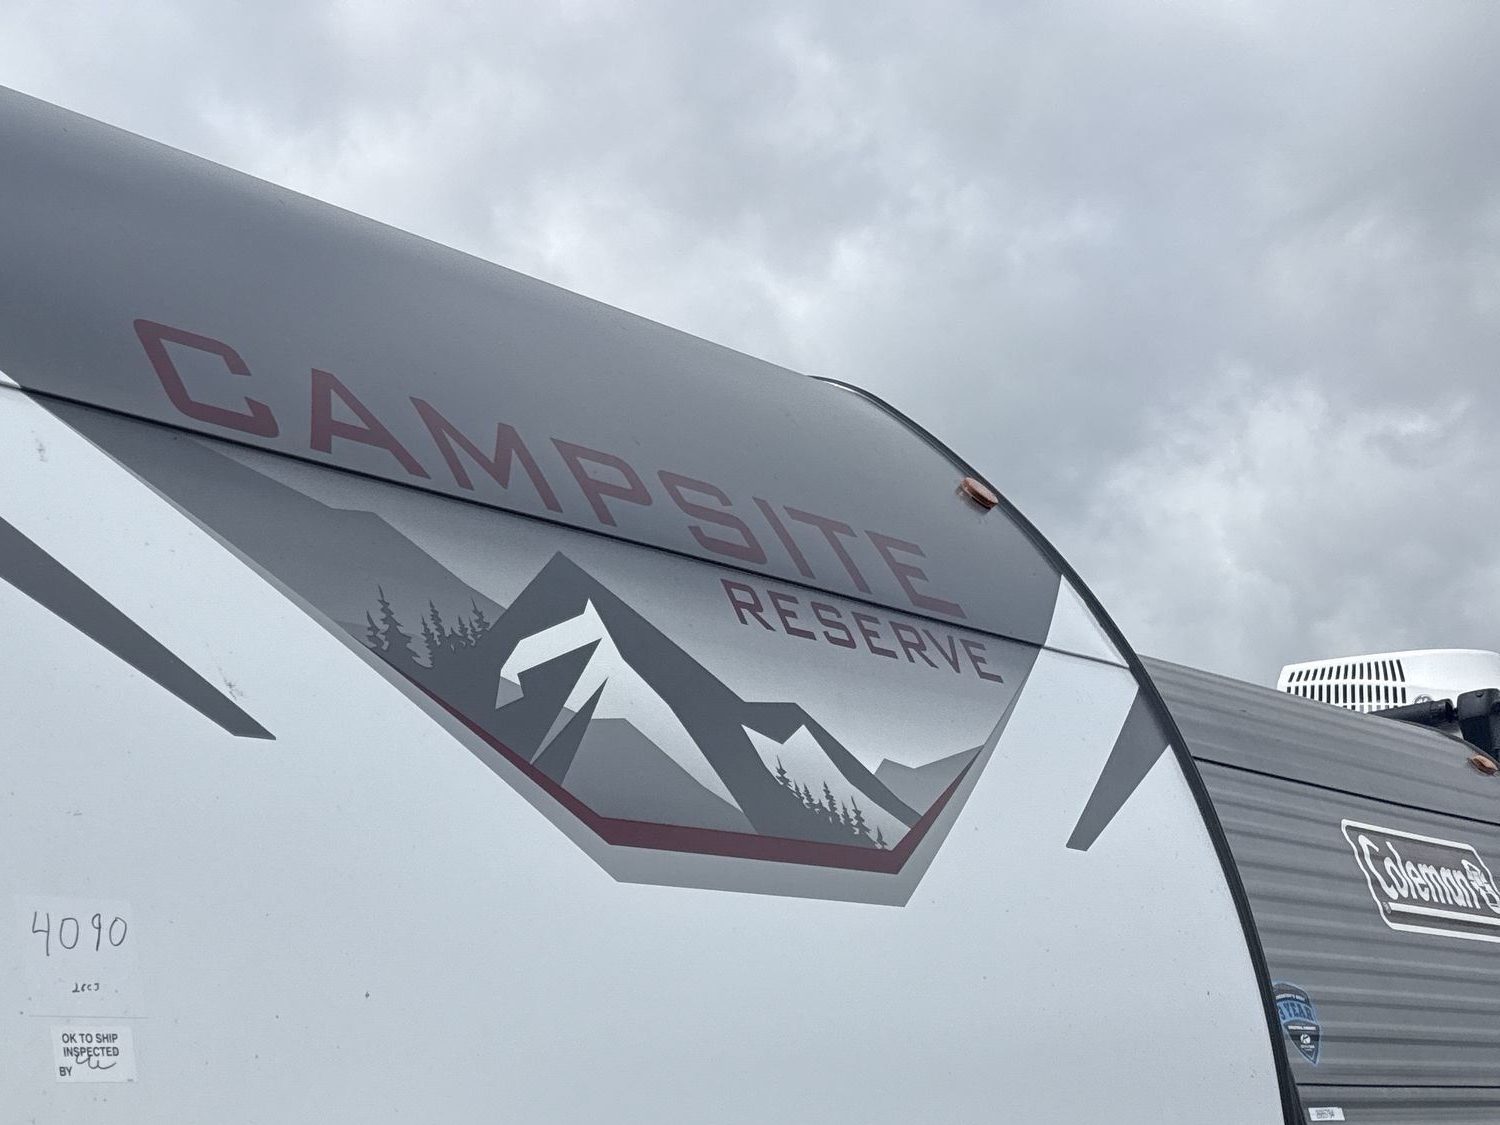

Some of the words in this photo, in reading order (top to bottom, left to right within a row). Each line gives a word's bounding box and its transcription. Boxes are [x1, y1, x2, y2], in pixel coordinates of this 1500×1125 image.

[133, 319, 966, 616] CAMPSITE
[719, 578, 1004, 684] RESERVE
[1358, 834, 1481, 909] Coleman
[31, 911, 127, 956] 4090
[1283, 1001, 1314, 1021] YEAR
[62, 1033, 77, 1043] OK
[79, 1033, 93, 1043] TO
[95, 1033, 118, 1043] SHIP
[63, 1046, 119, 1057] INSPECTED
[59, 1066, 72, 1076] BY
